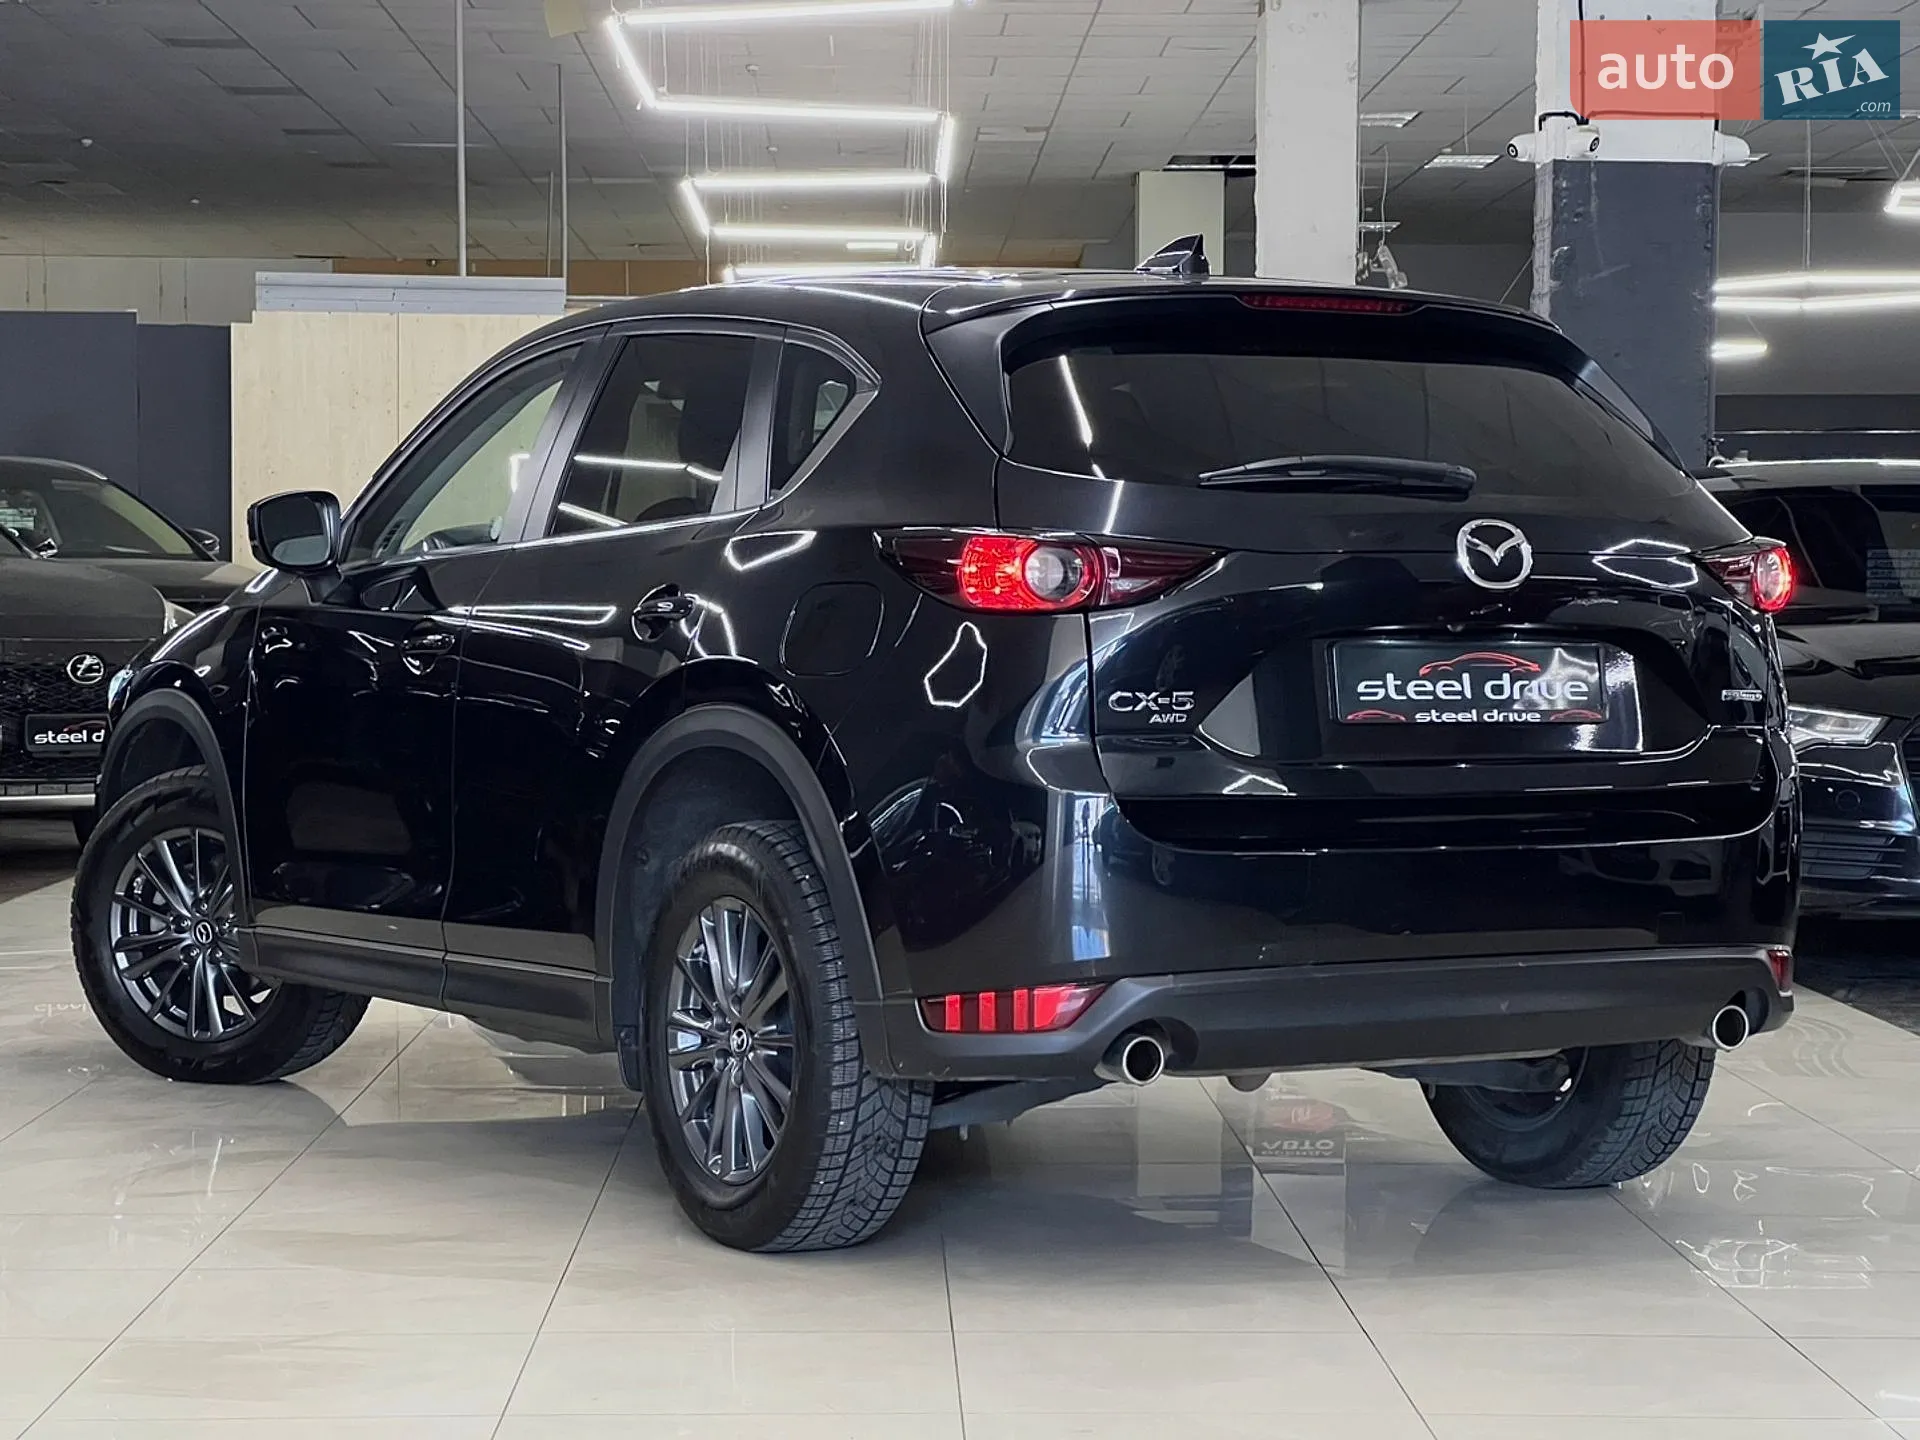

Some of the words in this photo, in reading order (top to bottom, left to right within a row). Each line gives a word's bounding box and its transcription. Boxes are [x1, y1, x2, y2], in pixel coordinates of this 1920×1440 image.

[1357, 672, 1473, 701] steel
[1484, 672, 1589, 701] drive
[1108, 690, 1195, 712] CX-5
[1149, 713, 1188, 724] AWD
[1415, 709, 1478, 723] steel
[1483, 709, 1541, 723] drive
[34, 730, 88, 744] steel
